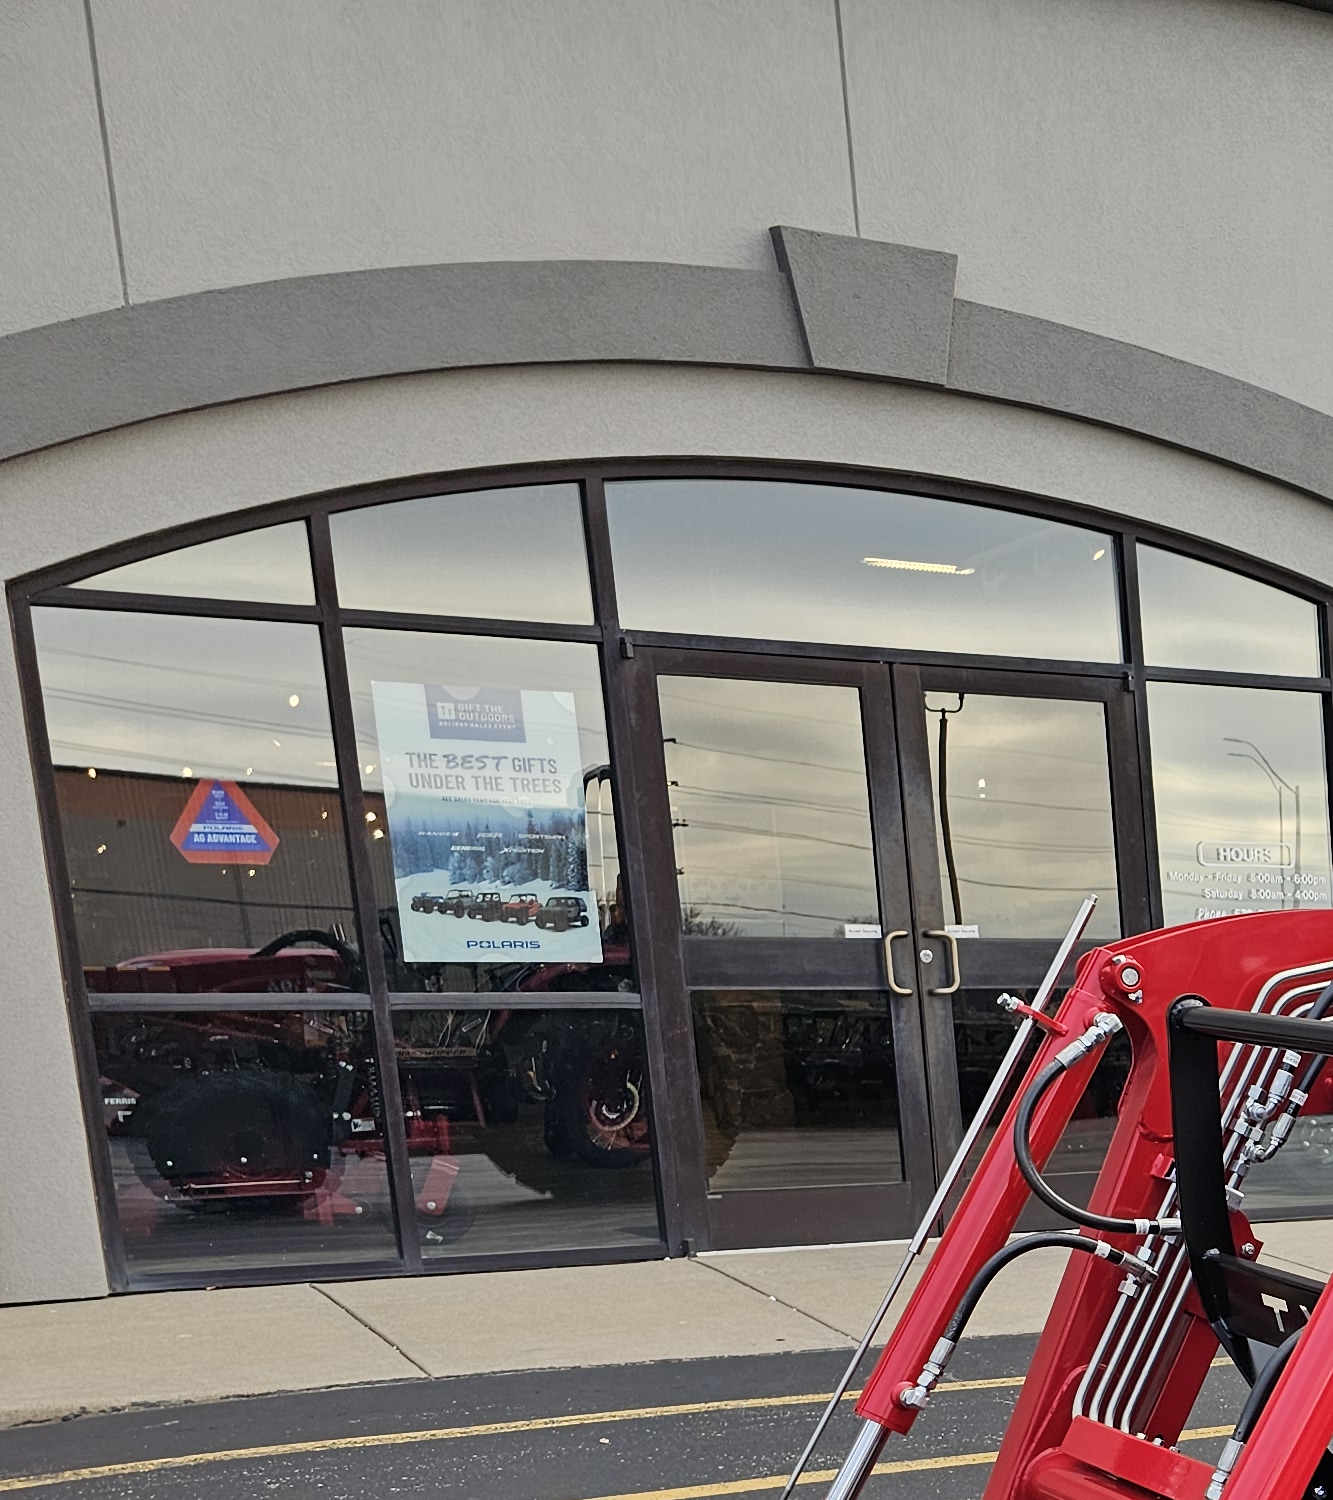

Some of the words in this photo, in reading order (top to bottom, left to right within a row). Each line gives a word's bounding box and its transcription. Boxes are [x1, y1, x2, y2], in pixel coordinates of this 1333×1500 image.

[458, 703, 481, 713] GIFT
[484, 705, 504, 714] THE
[459, 712, 516, 724] OUTDOORS
[405, 752, 439, 769] THE
[442, 753, 509, 771] BEST
[512, 757, 557, 774] GIFTS
[409, 772, 466, 791] UNDER
[471, 775, 505, 792] THE
[509, 776, 562, 794] TREES
[207, 834, 257, 844] ADVANTAGE
[1217, 847, 1272, 862] HOURS
[1168, 871, 1204, 884] Monday
[1214, 872, 1242, 884] Friday
[1249, 872, 1284, 884] 8:00am
[1293, 873, 1327, 885] 6:00pm
[1203, 888, 1243, 900] Saturday
[1250, 888, 1284, 900] 8:00am
[1294, 889, 1327, 901] 4:00pm
[466, 940, 541, 949] POLARIS
